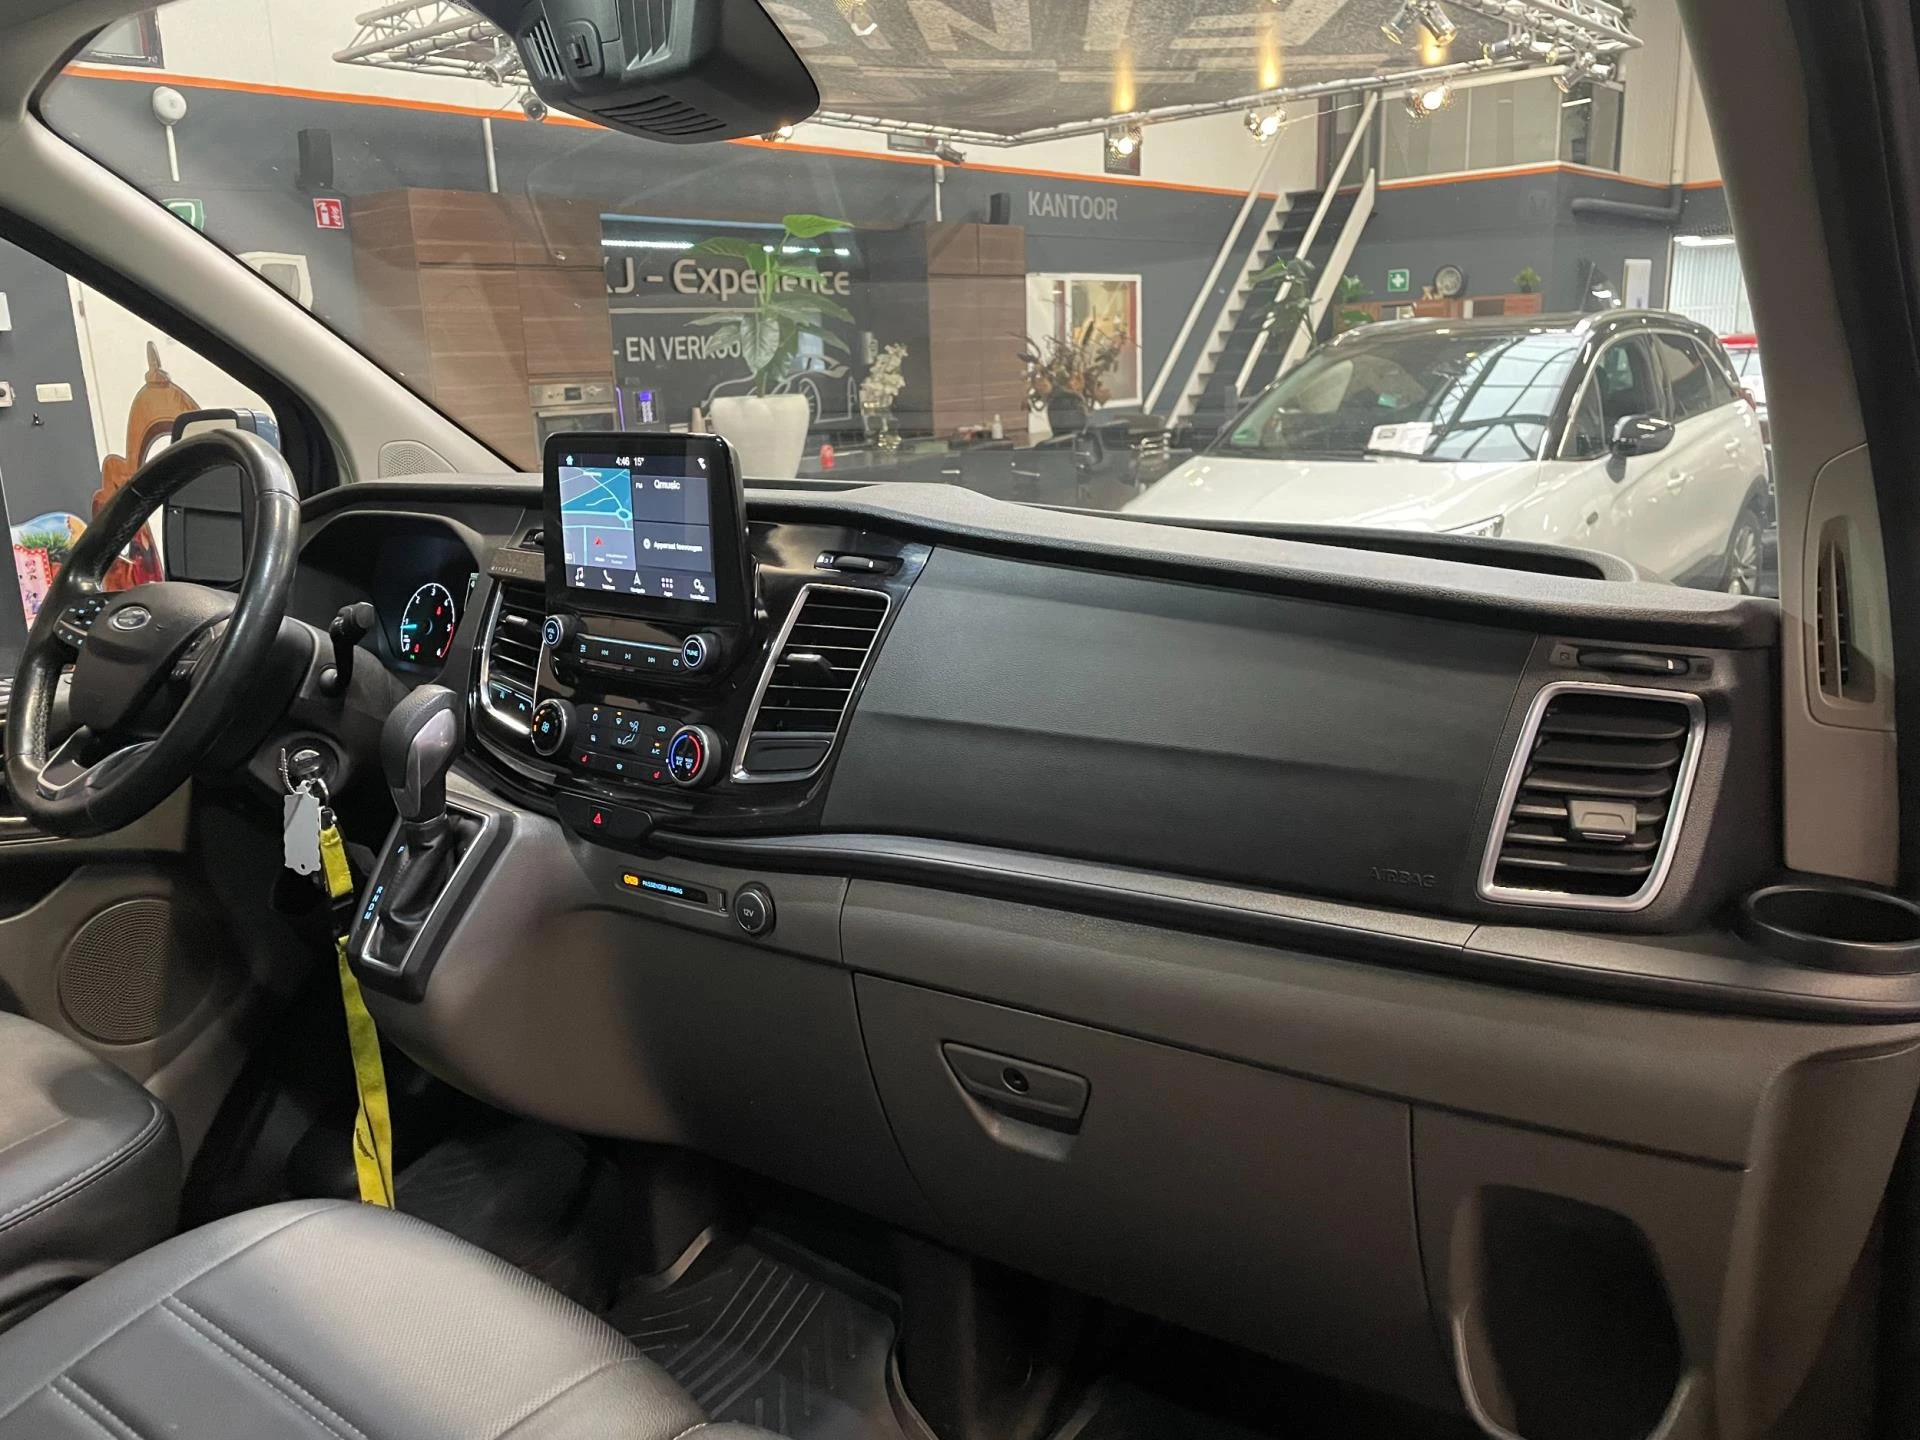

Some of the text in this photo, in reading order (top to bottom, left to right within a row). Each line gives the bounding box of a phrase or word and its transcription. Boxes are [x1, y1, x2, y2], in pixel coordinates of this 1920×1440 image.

[1027, 190, 1118, 221] KANTOOR
[604, 256, 635, 293] J
[625, 336, 656, 362] EN
[616, 456, 630, 466] 4:46
[653, 479, 681, 490] Qmusic
[686, 649, 699, 657] TUNE
